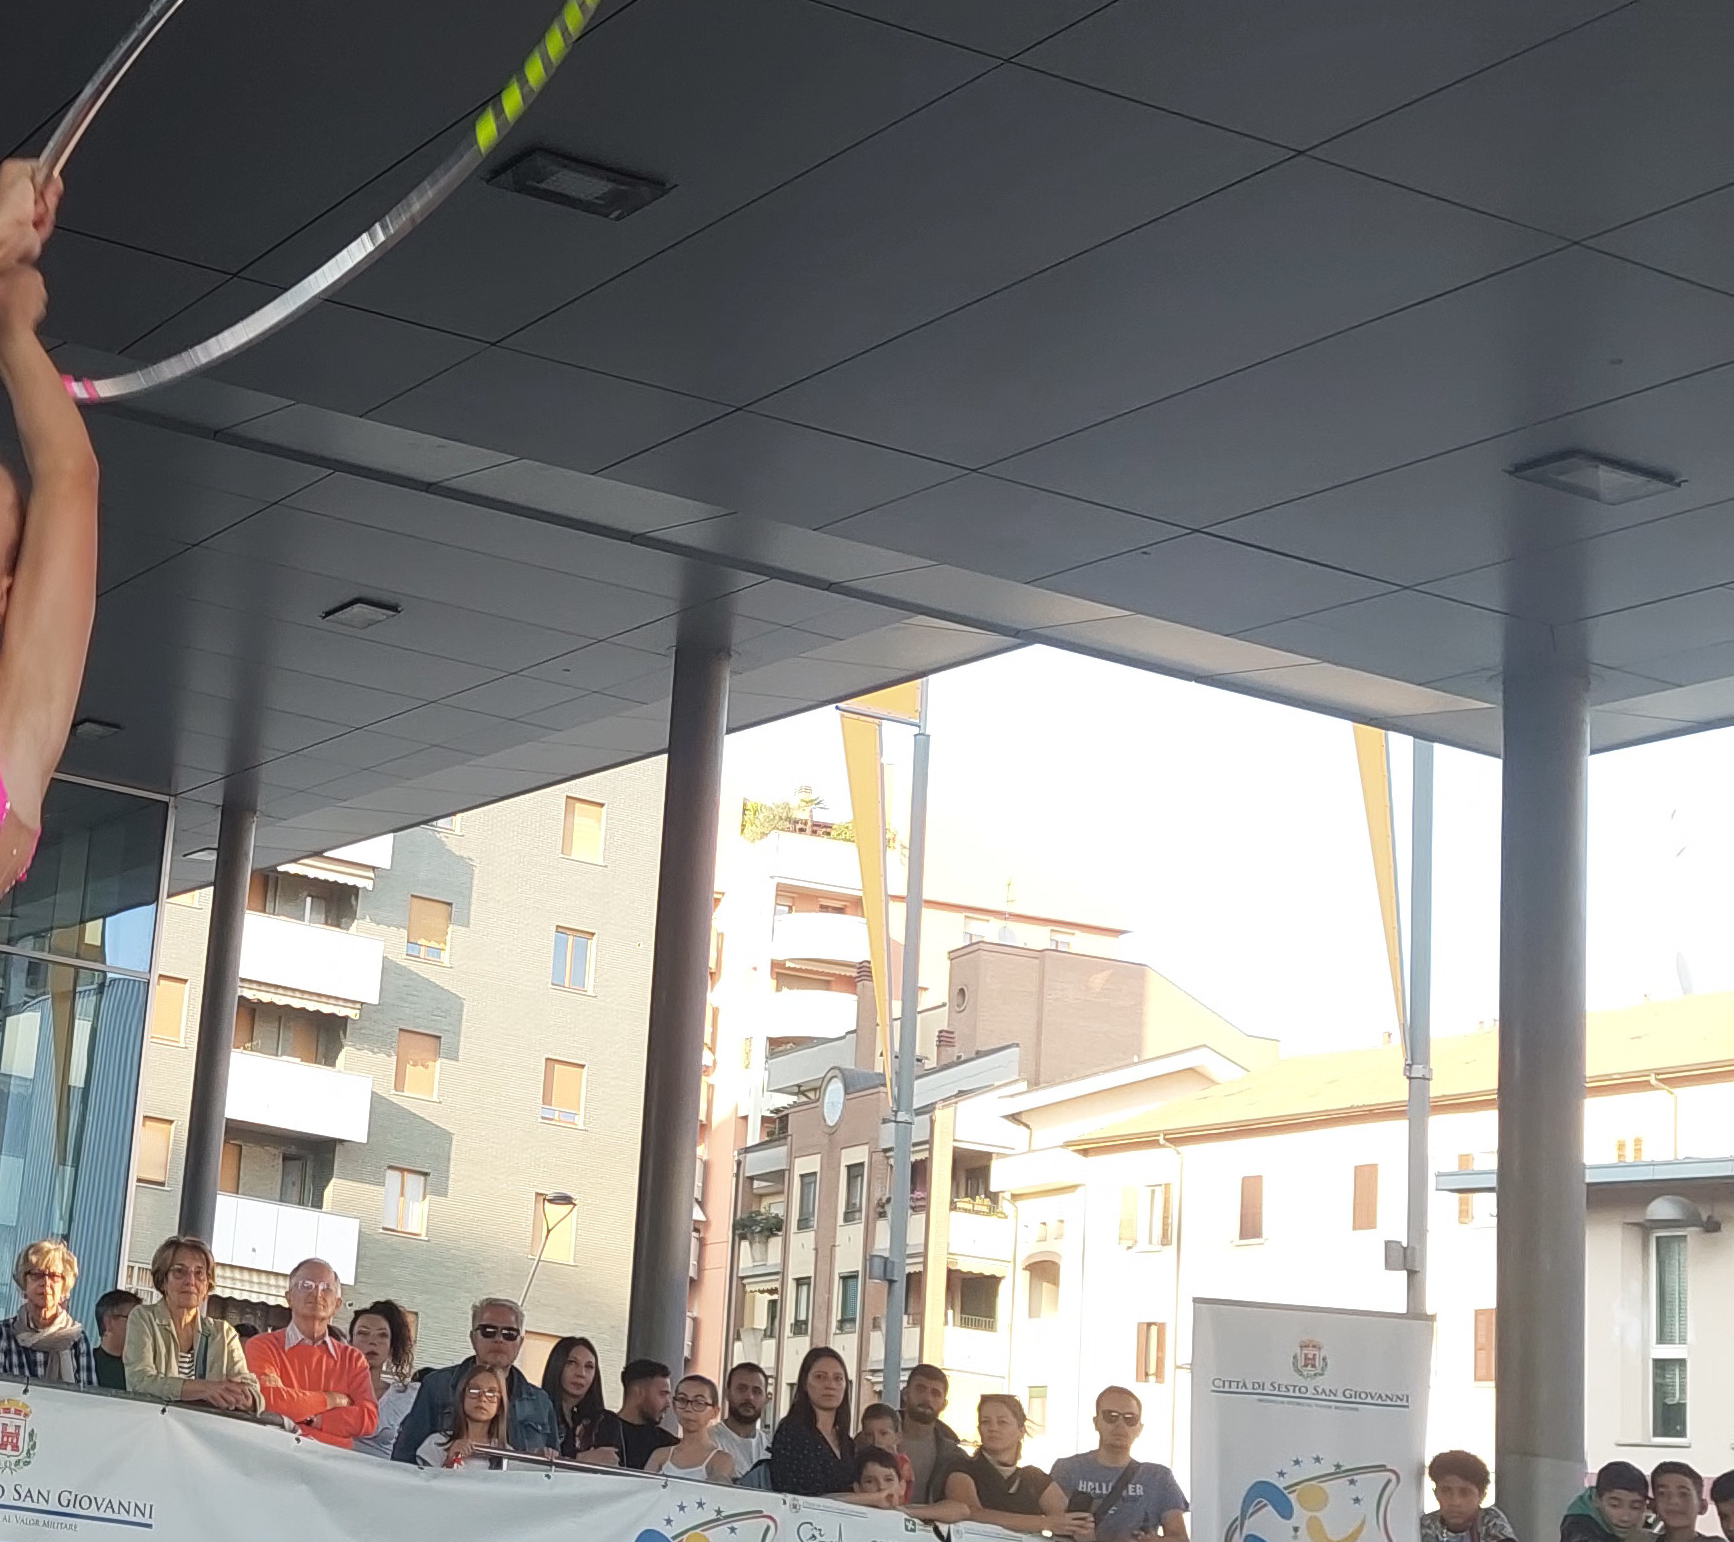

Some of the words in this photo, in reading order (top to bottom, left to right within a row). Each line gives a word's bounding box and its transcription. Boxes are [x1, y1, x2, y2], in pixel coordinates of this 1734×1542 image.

[1212, 1377, 1248, 1390] CITTÀ
[1252, 1381, 1265, 1392] DI
[1270, 1381, 1308, 1396] SESTO
[1313, 1385, 1338, 1398] SAN
[1342, 1388, 1410, 1404] GIOVANNI
[12, 1484, 51, 1506] SAN
[57, 1490, 154, 1520] GIOVANNI
